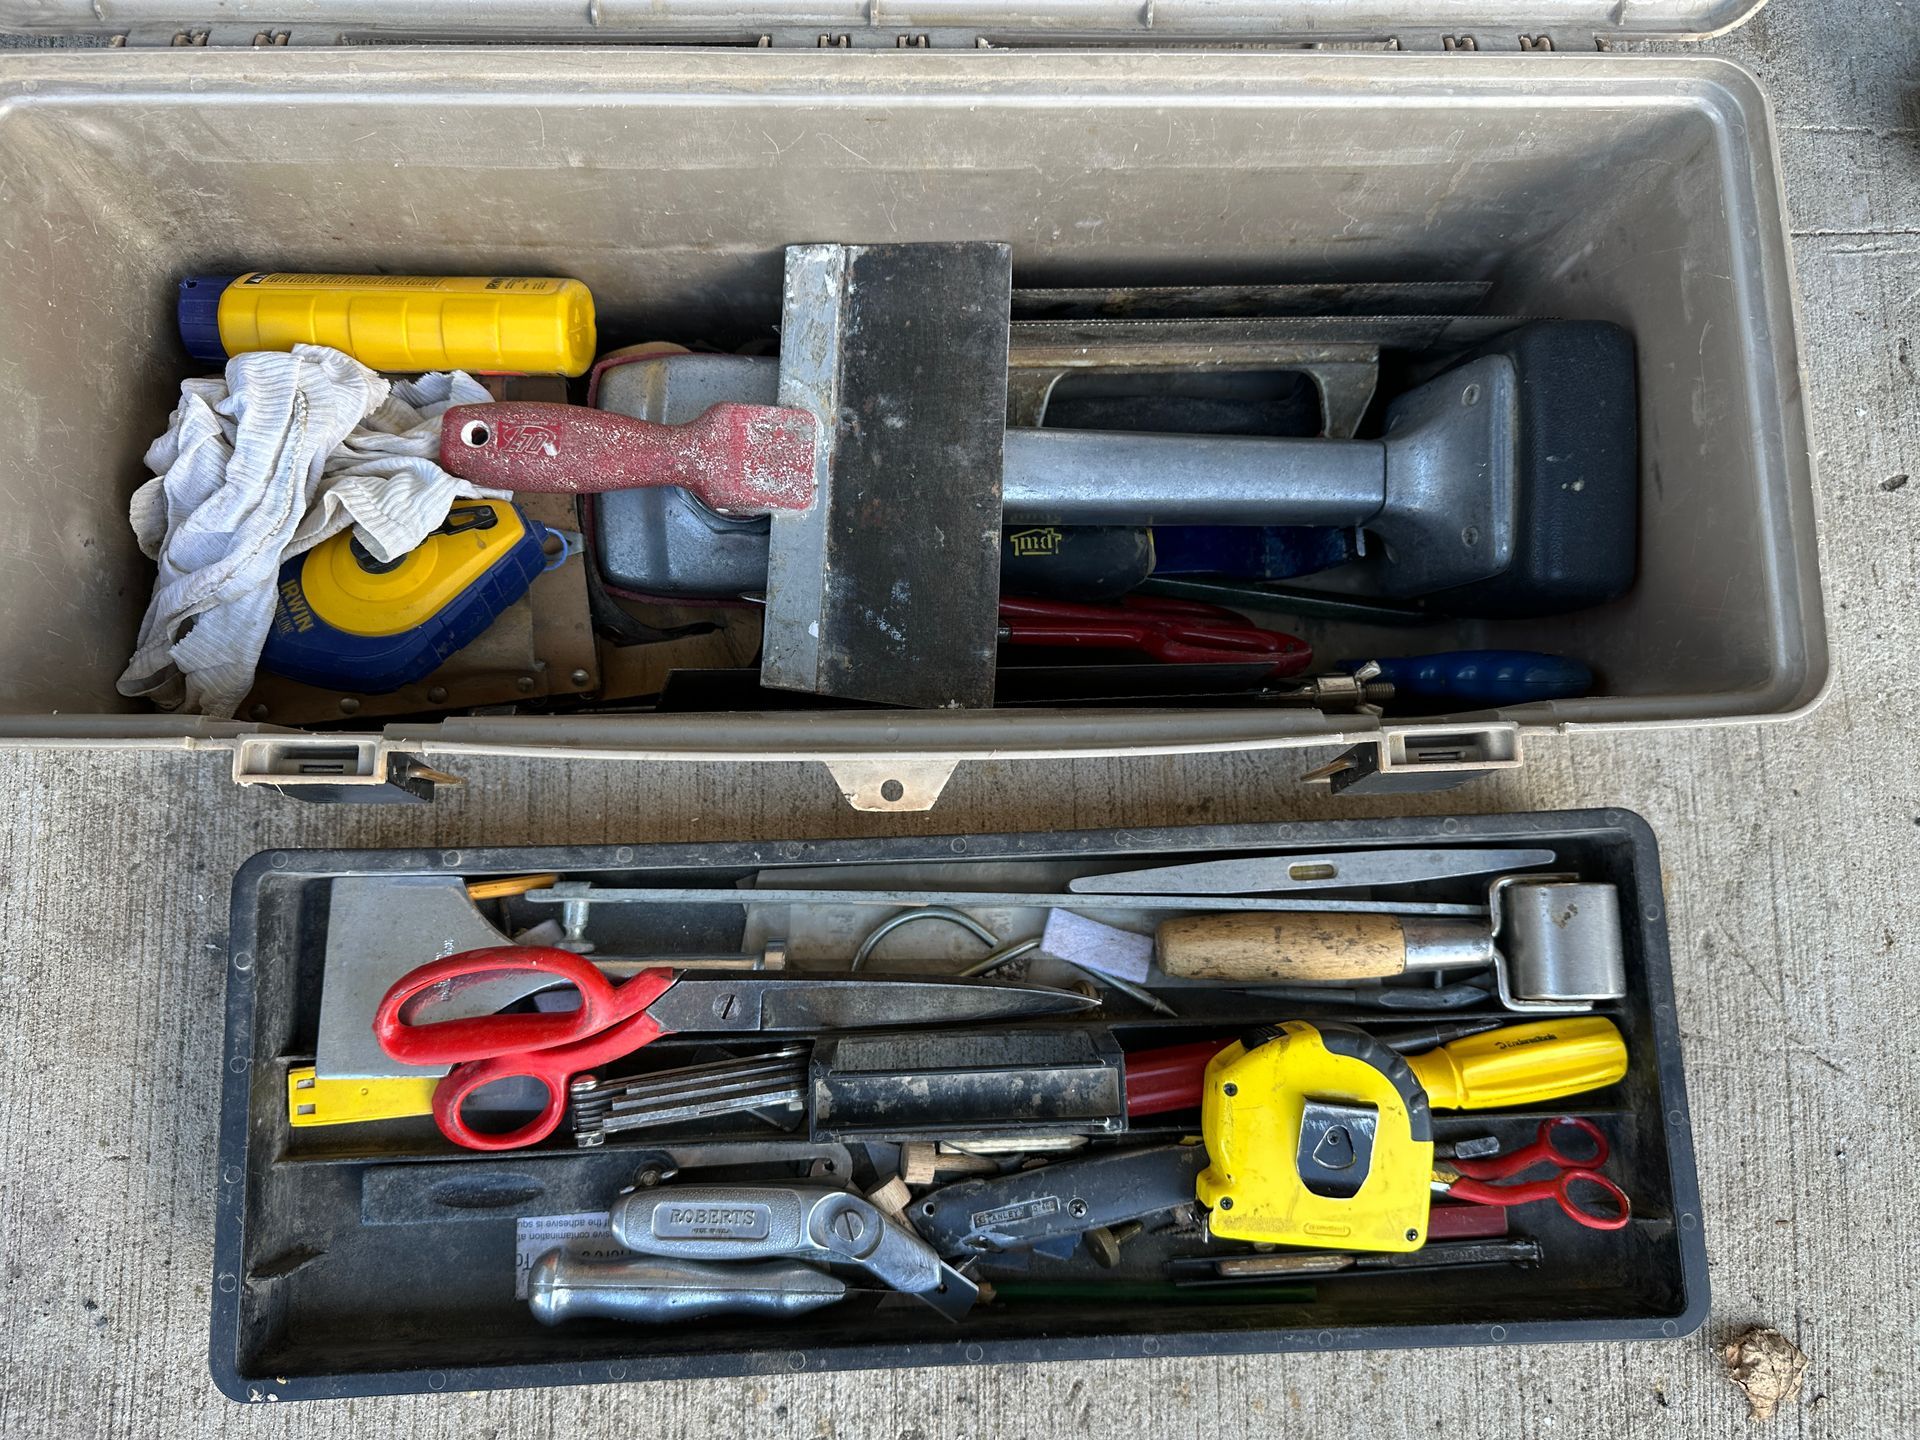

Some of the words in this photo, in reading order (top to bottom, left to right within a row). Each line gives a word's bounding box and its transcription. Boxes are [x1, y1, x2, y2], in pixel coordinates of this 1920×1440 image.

[281, 579, 314, 632] IRWIN
[670, 1208, 755, 1225] ROBERTS
[535, 1220, 543, 1228] is
[546, 1219, 585, 1228] adhesive
[587, 1219, 602, 1227] the
[530, 1231, 590, 1241] contamination
